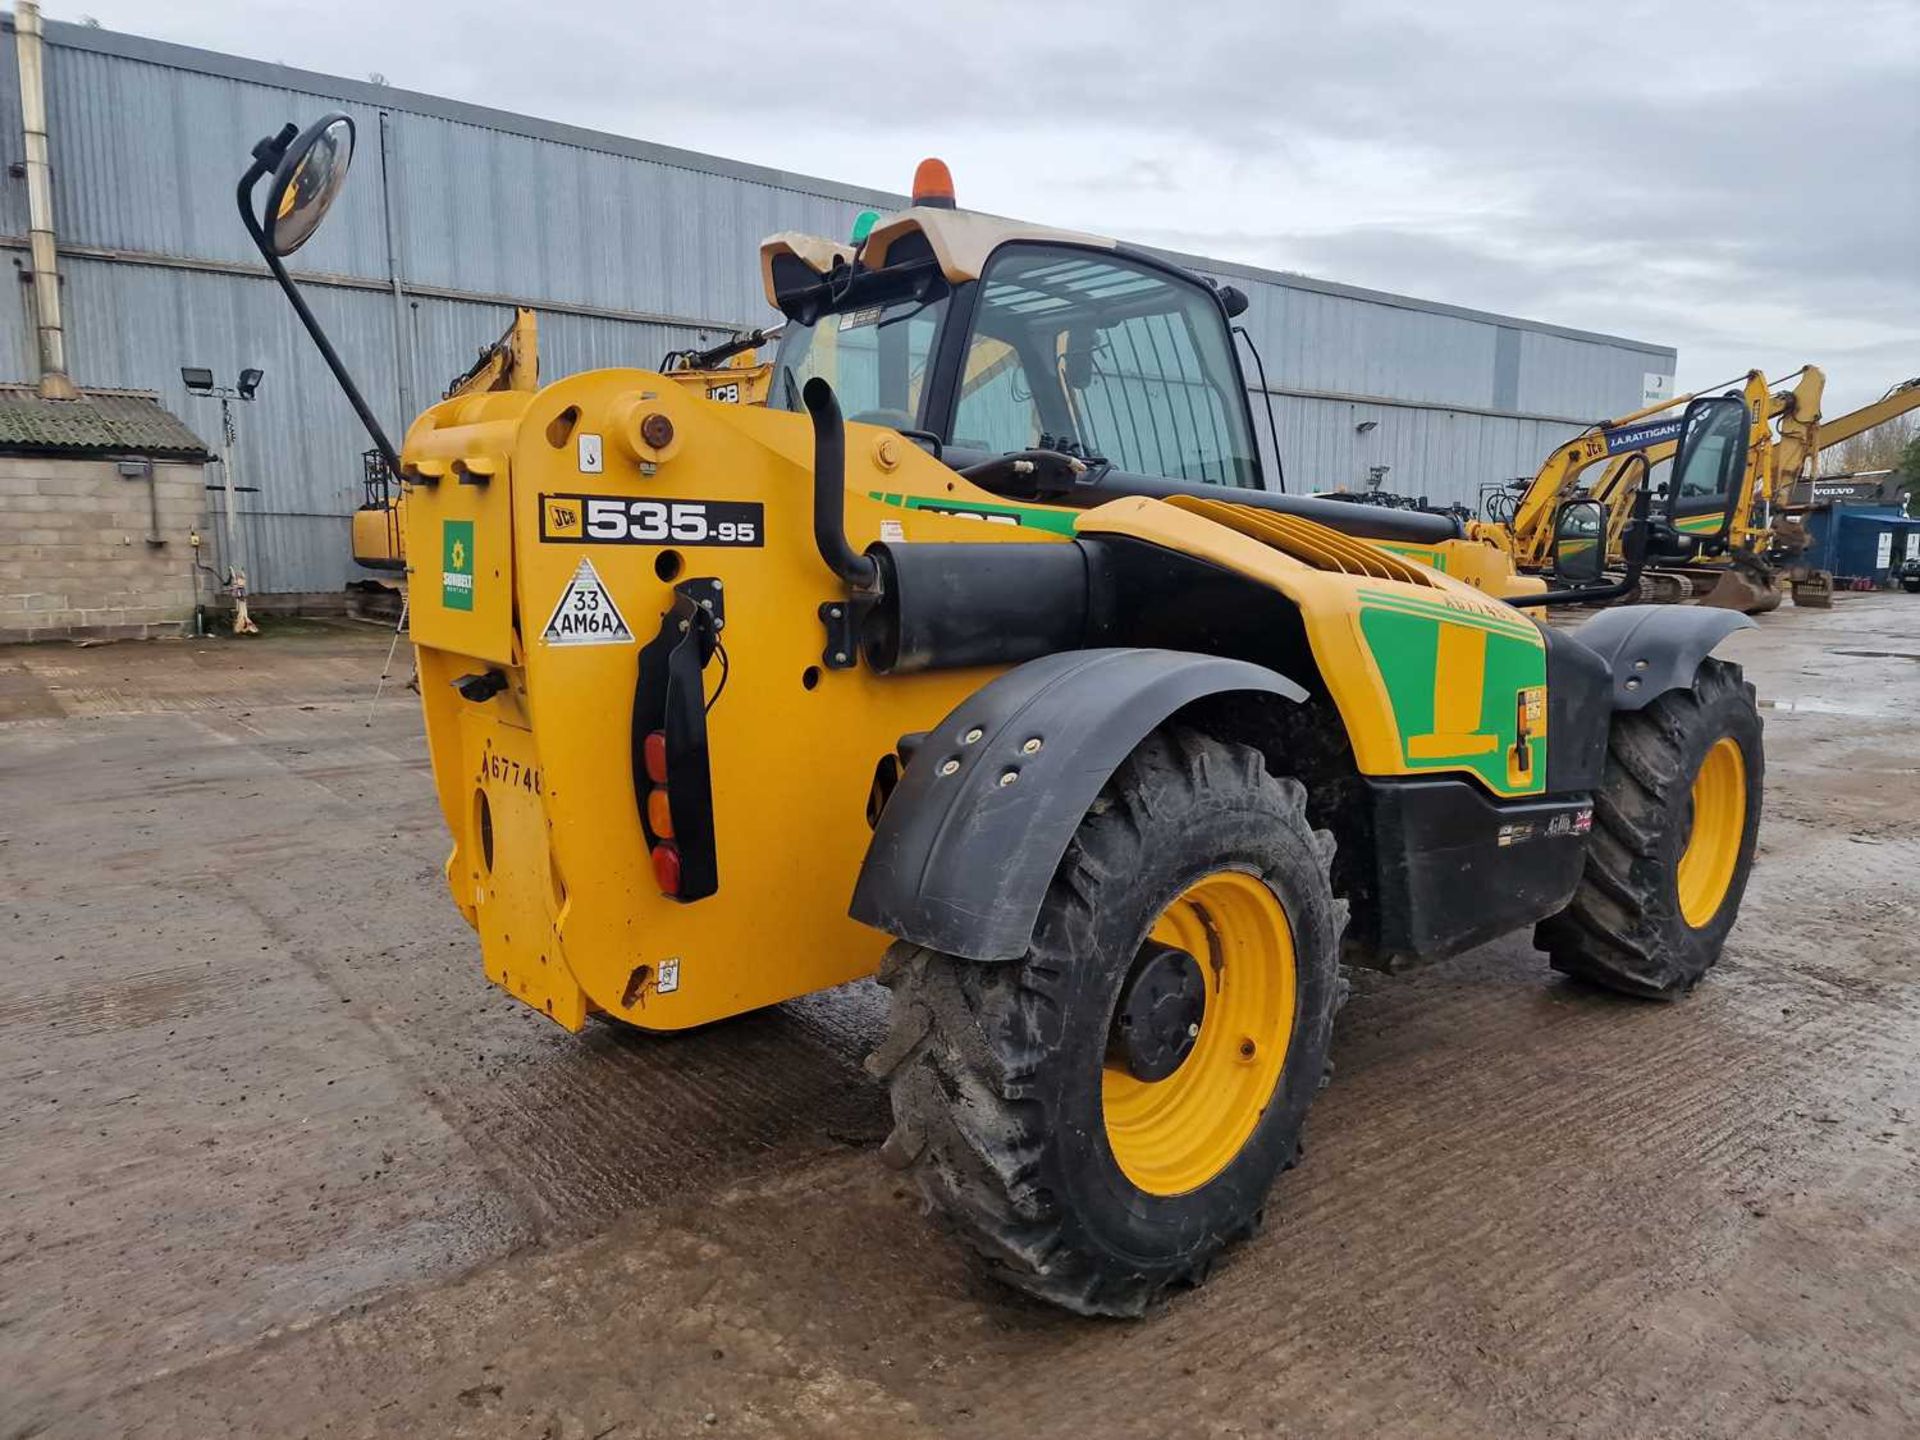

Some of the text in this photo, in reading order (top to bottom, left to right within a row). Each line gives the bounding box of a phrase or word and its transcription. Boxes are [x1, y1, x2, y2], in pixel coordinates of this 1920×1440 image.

[1814, 487, 1855, 495] VOLVO
[554, 500, 756, 542] JCB 535-95
[573, 590, 600, 612] 33
[560, 612, 614, 634] AM6A
